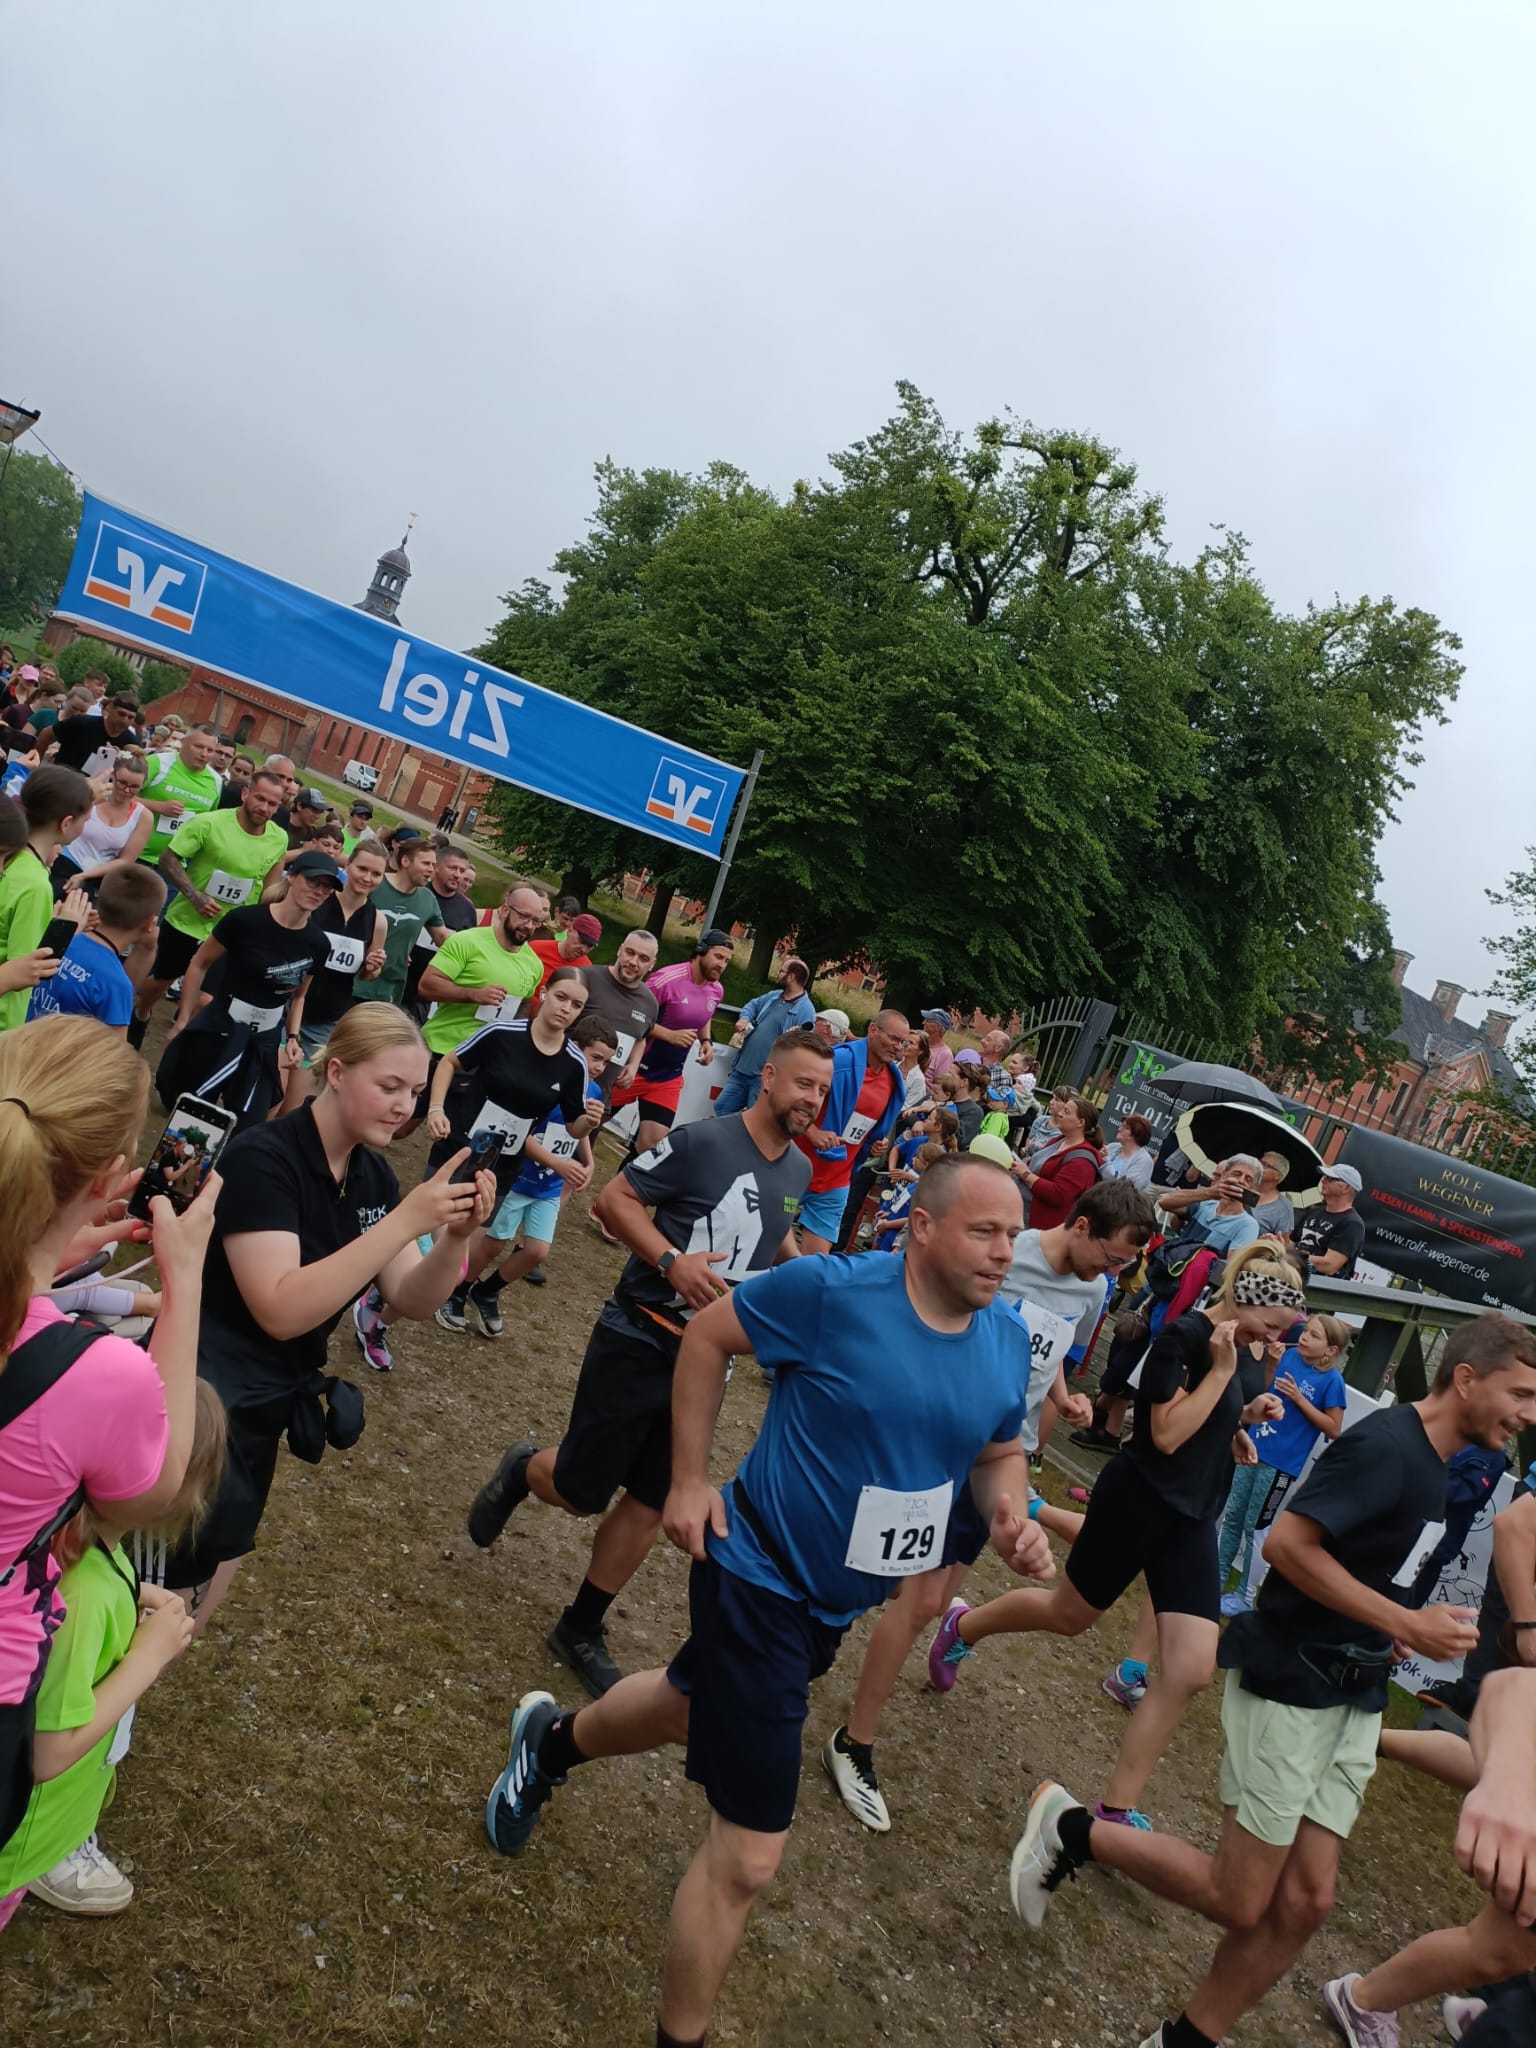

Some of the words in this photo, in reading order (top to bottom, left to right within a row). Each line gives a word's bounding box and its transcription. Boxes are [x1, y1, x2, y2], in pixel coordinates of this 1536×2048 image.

[217, 884, 242, 900] 115
[327, 948, 355, 967] 140
[1133, 1047, 1166, 1080] Ha
[1143, 1106, 1177, 1131] 017
[552, 1139, 576, 1155] 201
[1441, 1168, 1485, 1194] ROLF
[1418, 1177, 1495, 1218] WEGENER
[1375, 1226, 1490, 1283] www.rolf-wegener.de
[880, 1524, 935, 1561] 129
